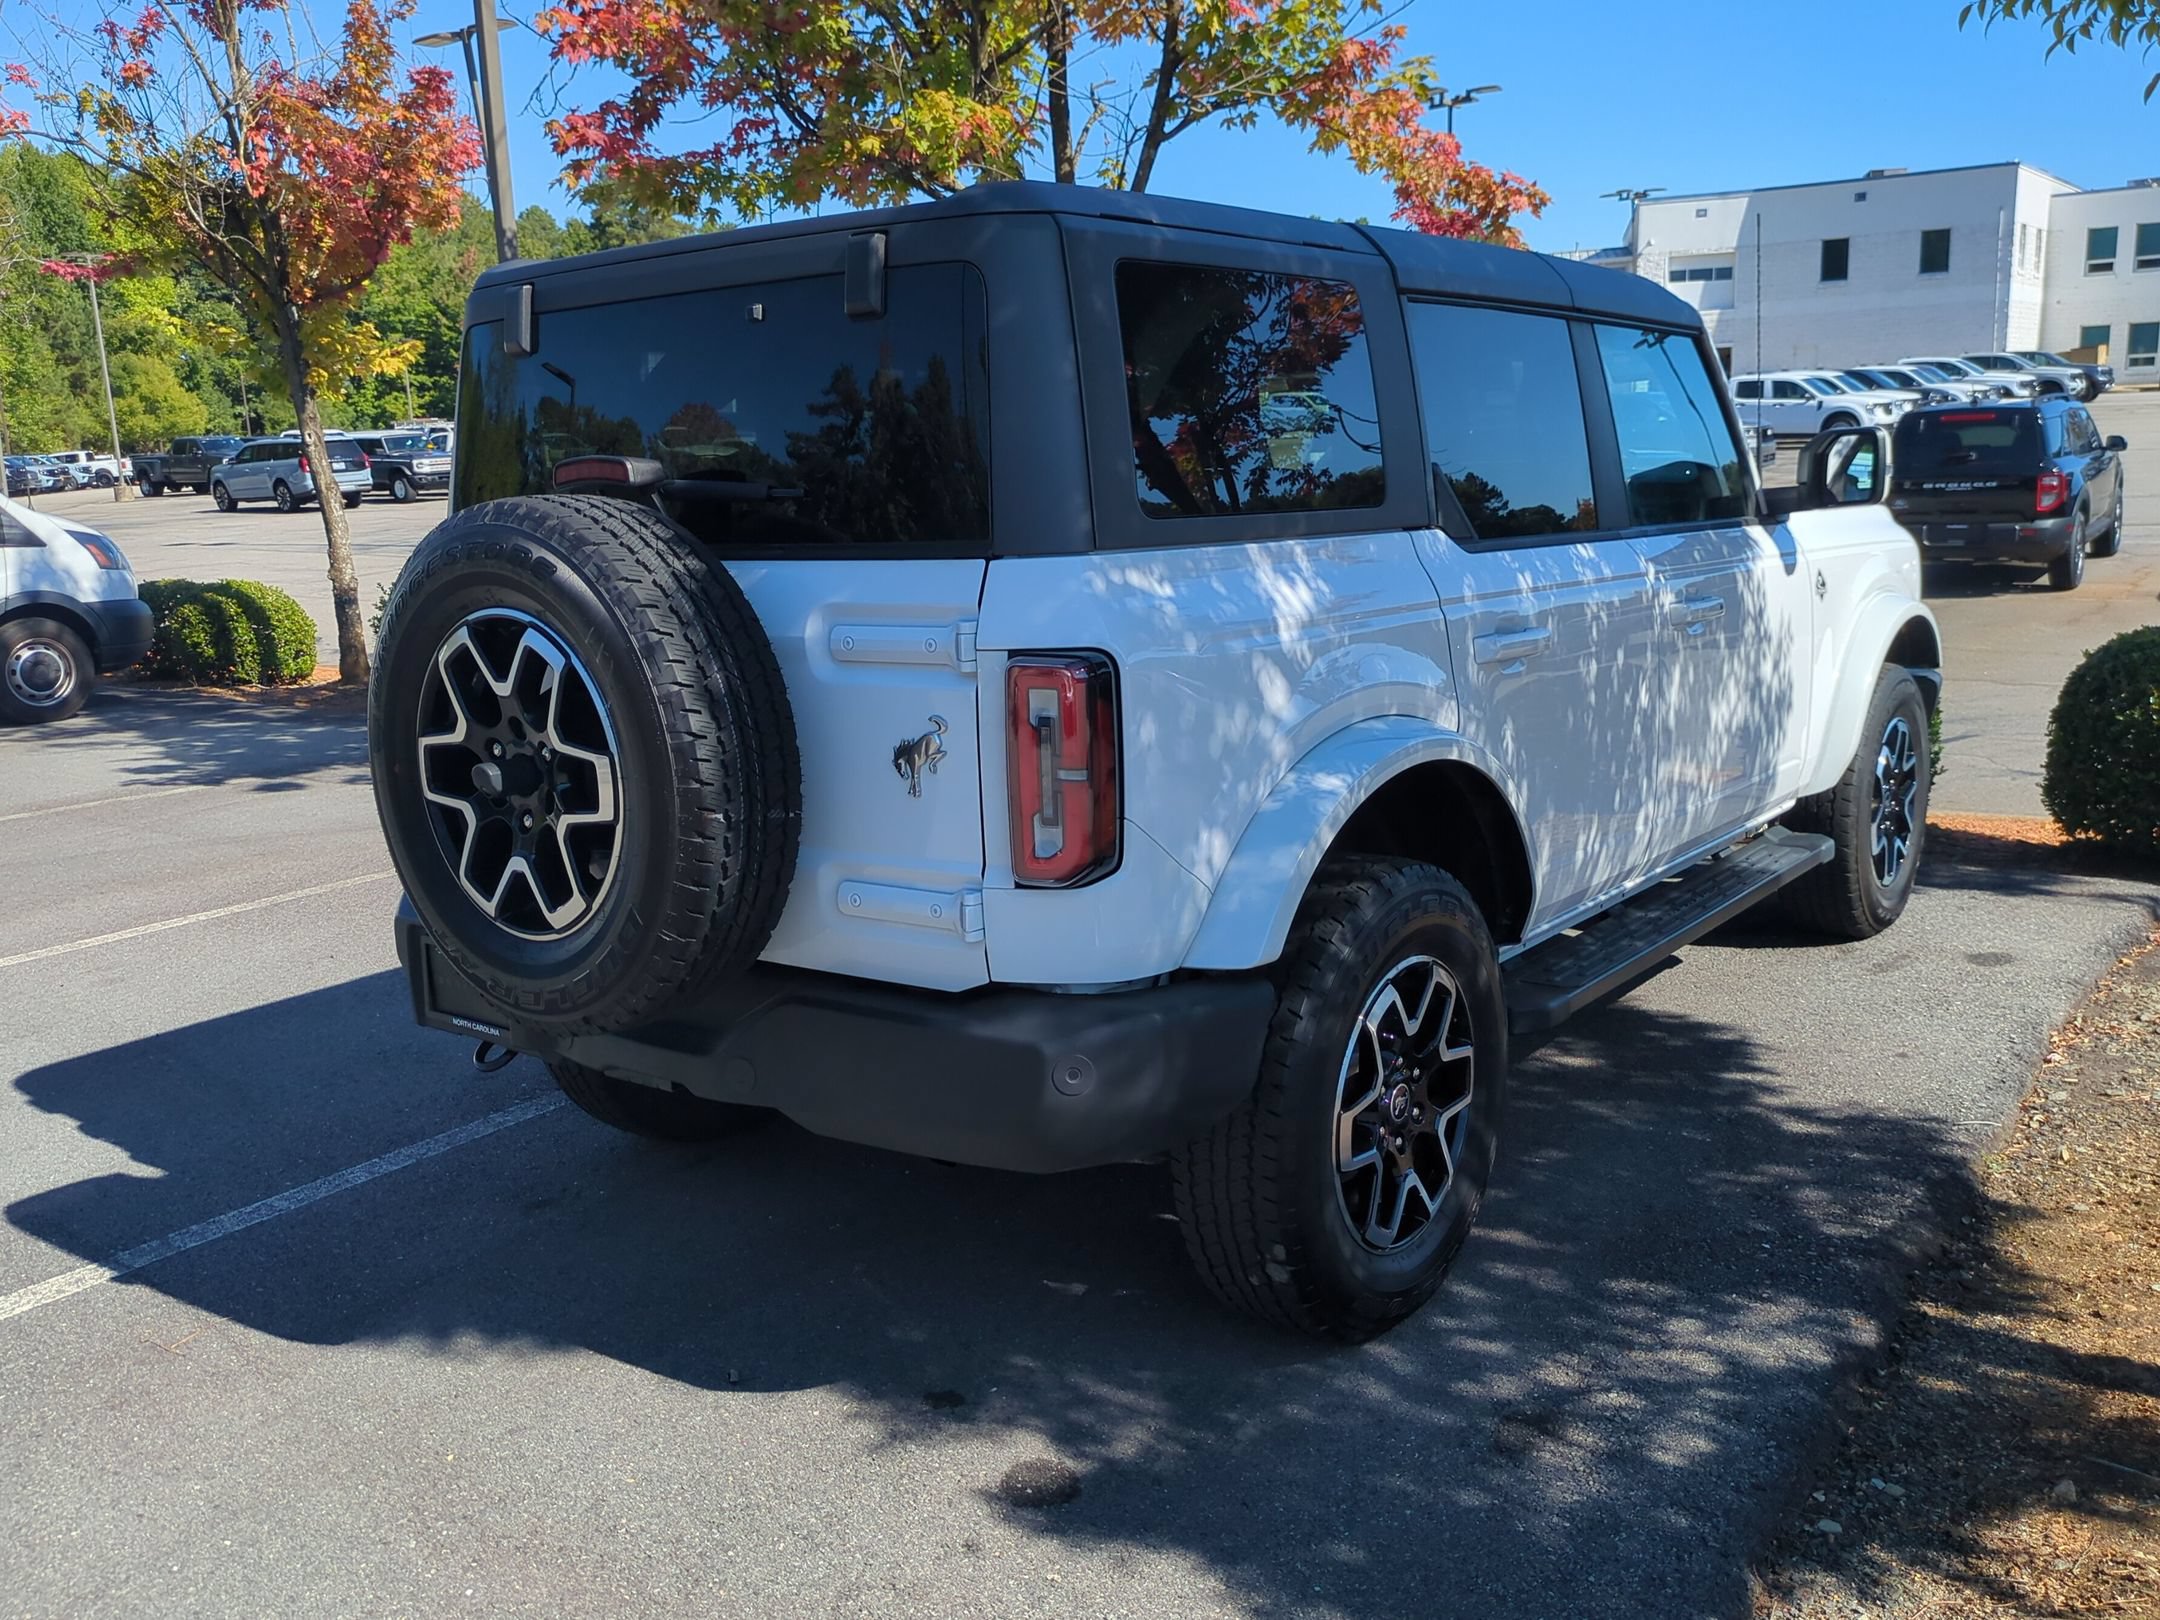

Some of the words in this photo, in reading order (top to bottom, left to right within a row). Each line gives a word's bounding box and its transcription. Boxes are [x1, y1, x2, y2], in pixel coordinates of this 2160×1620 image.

[371, 541, 558, 704] BRIDGESTONE
[452, 1017, 472, 1029] NORTH
[472, 1022, 500, 1037] CAROLINA
